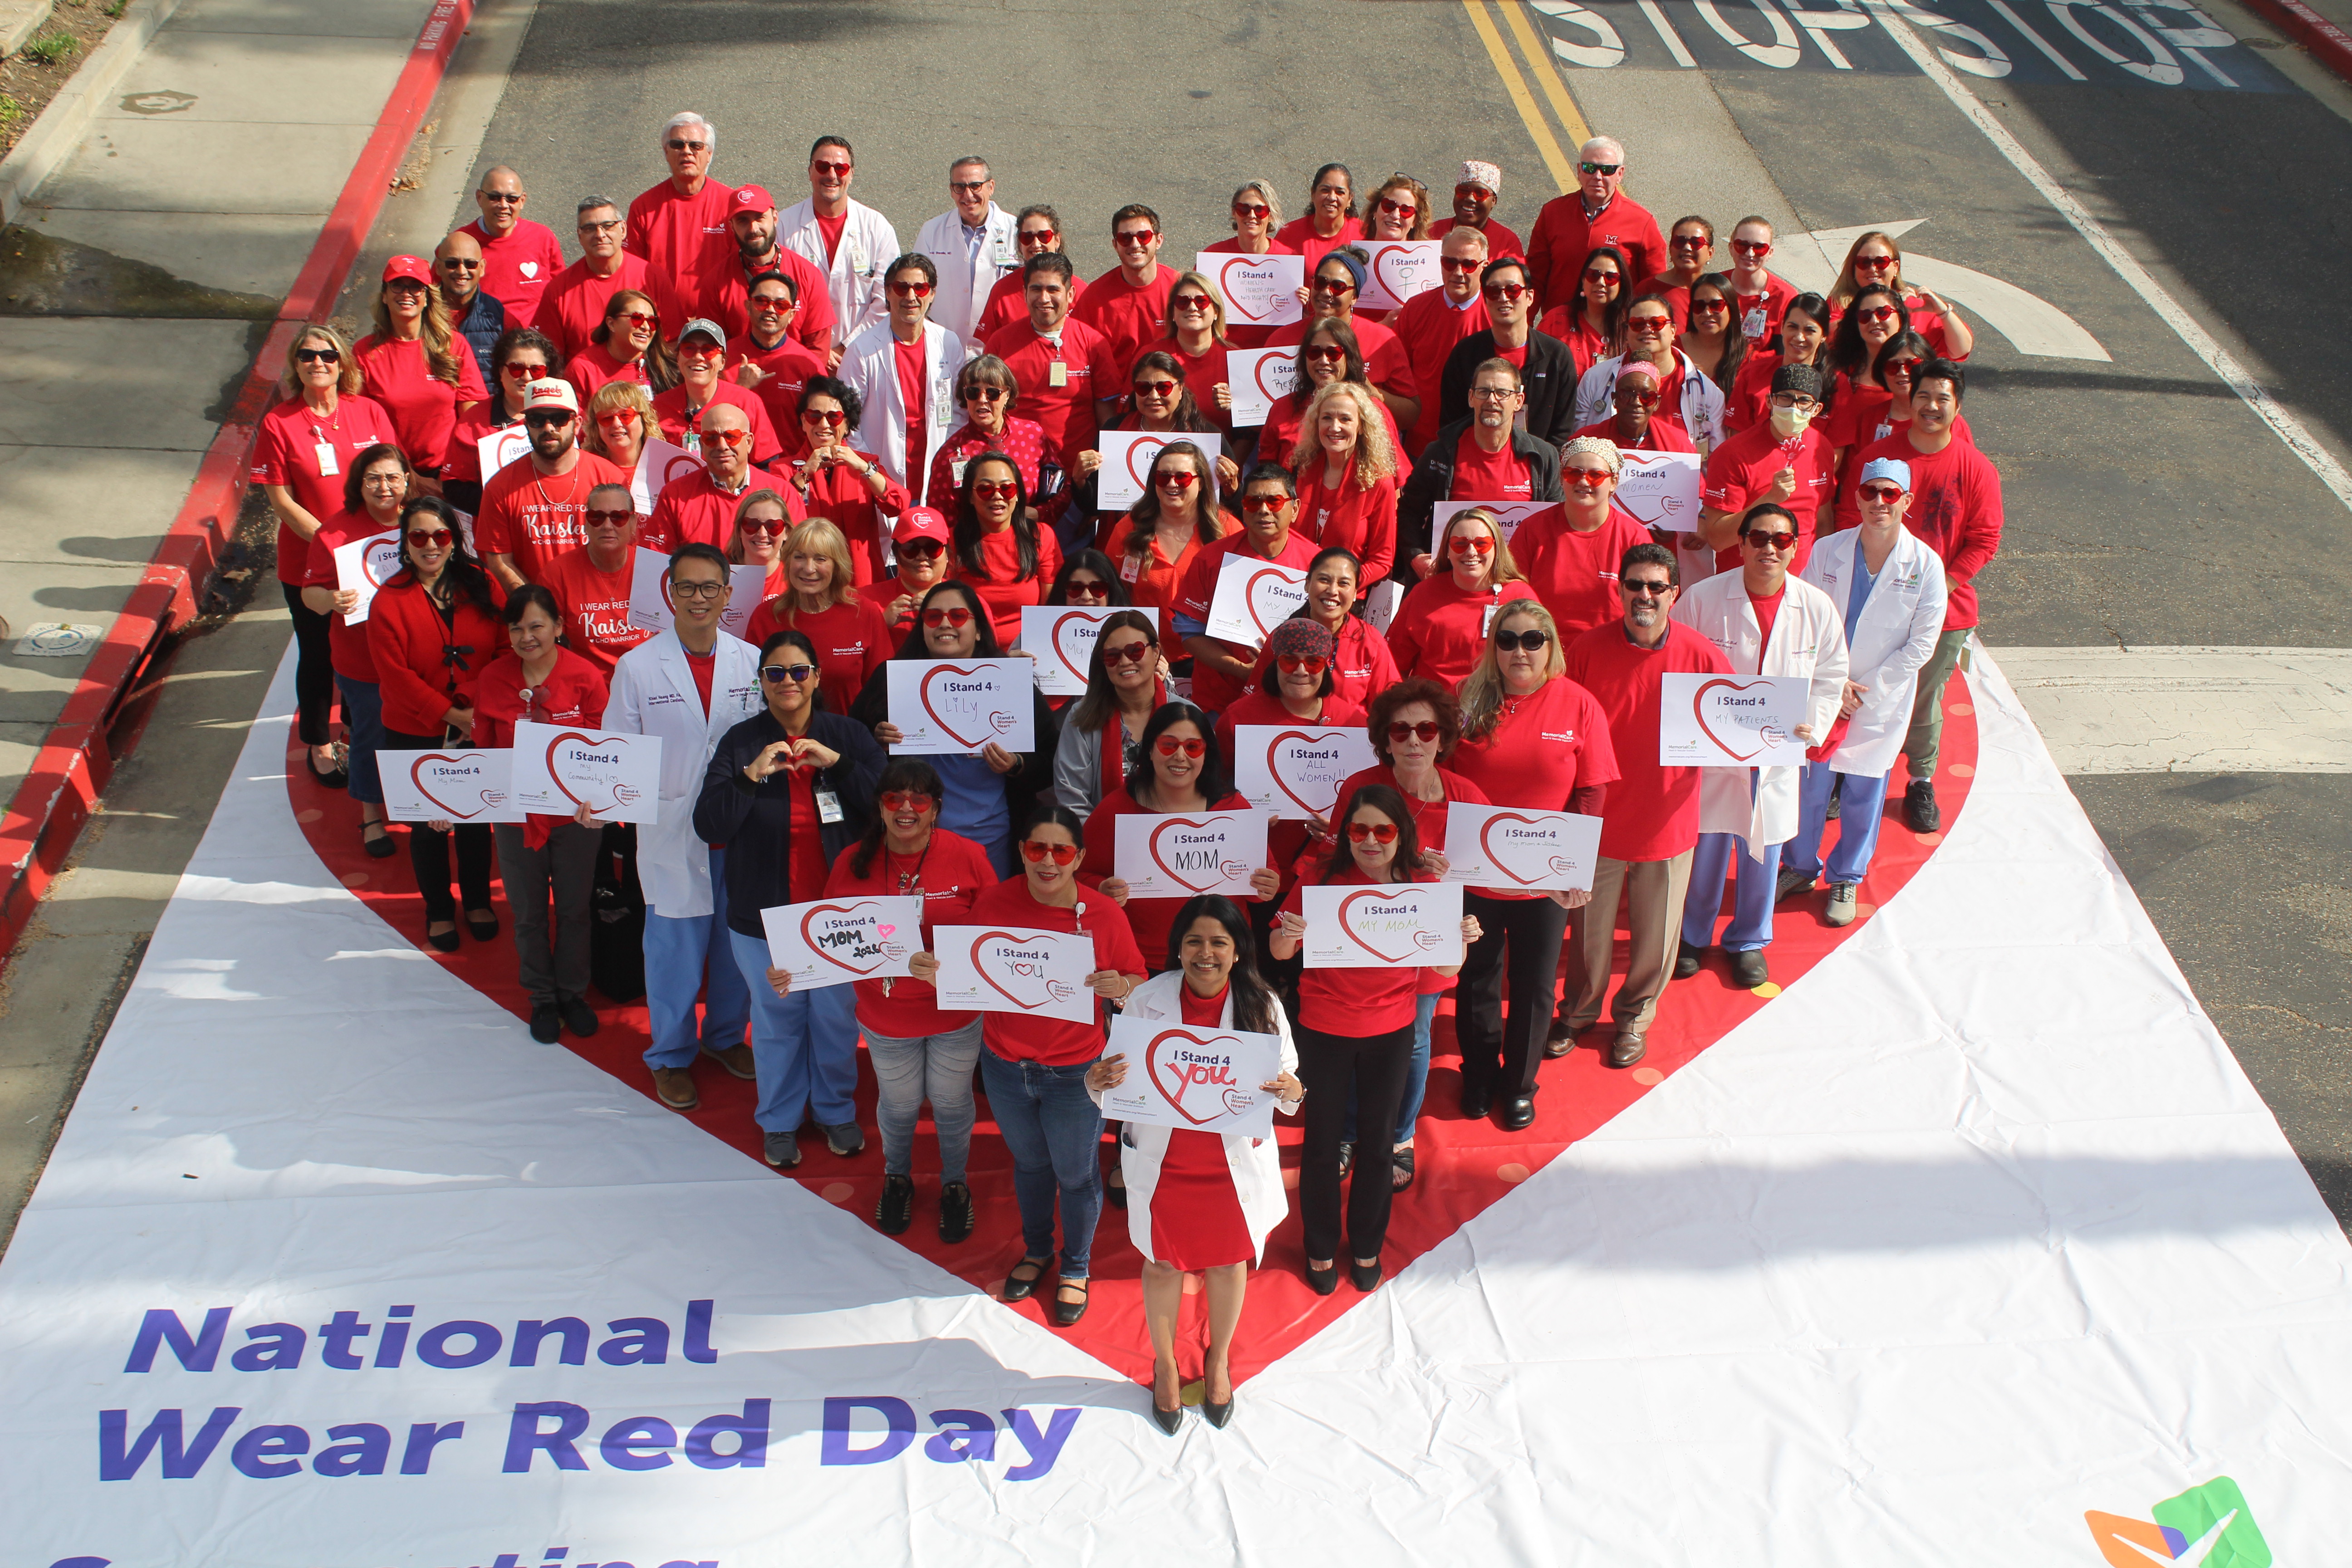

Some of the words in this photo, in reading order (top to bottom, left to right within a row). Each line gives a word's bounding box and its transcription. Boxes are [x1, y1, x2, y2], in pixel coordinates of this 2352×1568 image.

[701, 321, 717, 331] BEACH
[1631, 469, 1657, 478] Stand
[1273, 587, 1303, 601] Stand
[612, 600, 630, 609] RED
[610, 634, 640, 642] WARRIOR
[1074, 629, 1077, 637] I
[944, 683, 947, 691] I
[950, 682, 982, 691] Stand
[985, 682, 992, 691] 4
[1718, 696, 1720, 705] I
[1723, 697, 1755, 706] Stand
[1759, 697, 1765, 706] 4
[1715, 713, 1728, 724] MY
[1734, 715, 1779, 725] PATIENTS
[570, 750, 573, 759] I
[576, 751, 608, 763] Stand
[612, 755, 618, 764] 4
[1291, 750, 1293, 758] I
[1297, 750, 1328, 759] Stand
[1332, 750, 1338, 759] 4
[1307, 760, 1326, 769] ALL
[568, 772, 603, 785] Community
[1181, 834, 1215, 843] Stand
[1218, 833, 1225, 842] 4
[1512, 829, 1546, 838] Stand
[1176, 849, 1218, 871] MOM
[1365, 906, 1367, 915] I
[1371, 906, 1406, 915] Stand
[1410, 905, 1417, 913] 4
[832, 917, 866, 928] Stand
[1358, 920, 1377, 931] MY
[818, 930, 865, 948] MOM
[853, 944, 880, 958] 2026
[1003, 949, 1039, 959] Stand
[1174, 1050, 1178, 1060] I
[1181, 1051, 1219, 1064] Stand
[1222, 1056, 1230, 1065] 4
[127, 1300, 717, 1372] National
[102, 1408, 464, 1480] Wear
[504, 1399, 770, 1473] Red
[822, 1397, 1081, 1480] Day
